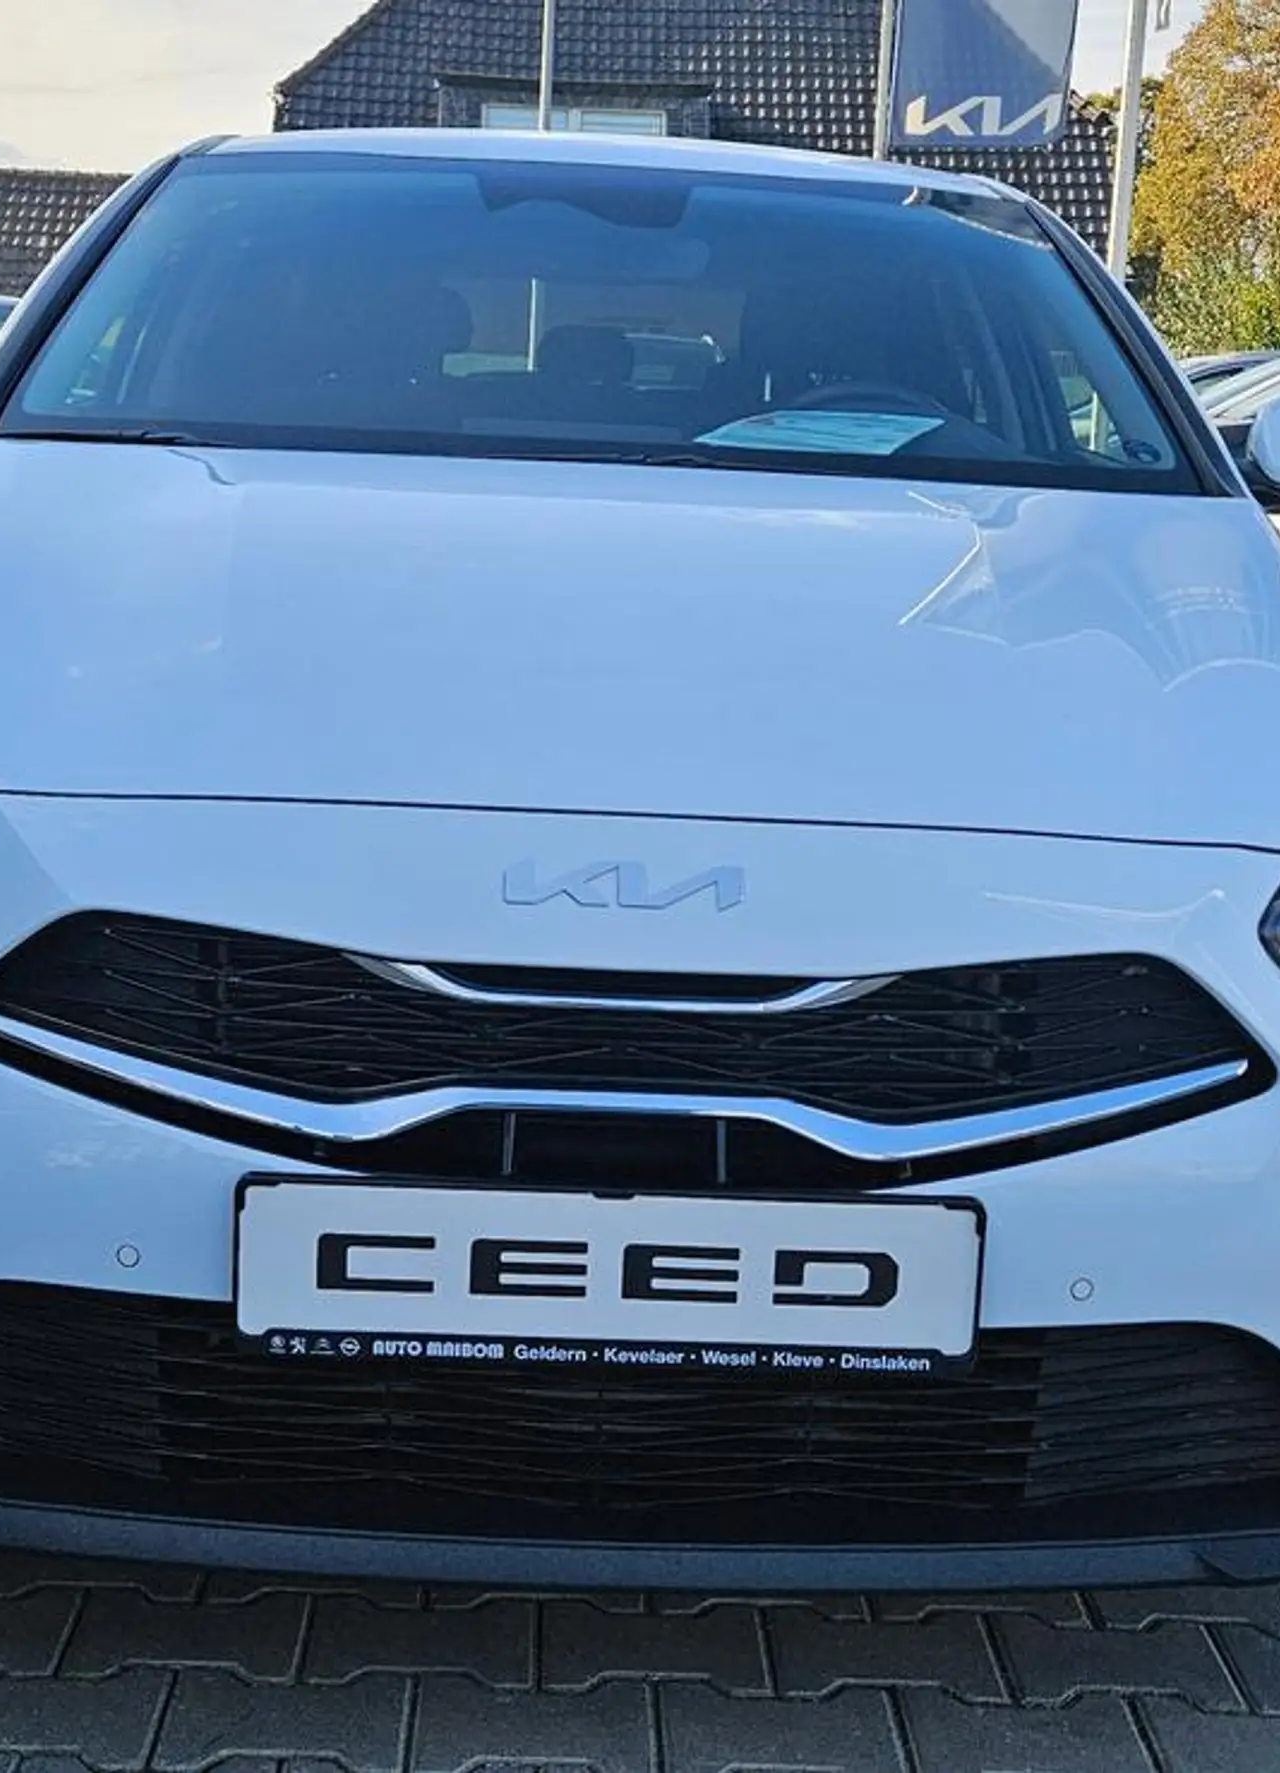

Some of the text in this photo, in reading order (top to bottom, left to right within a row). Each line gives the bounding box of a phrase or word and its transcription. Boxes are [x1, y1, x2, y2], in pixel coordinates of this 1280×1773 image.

[905, 92, 1066, 136] KIA
[502, 858, 746, 912] KIA
[316, 1231, 900, 1308] CEED
[373, 1339, 931, 1372] AUTO MAIBOM Geldern Kevelaer Wesel Kleve Dinslaken
